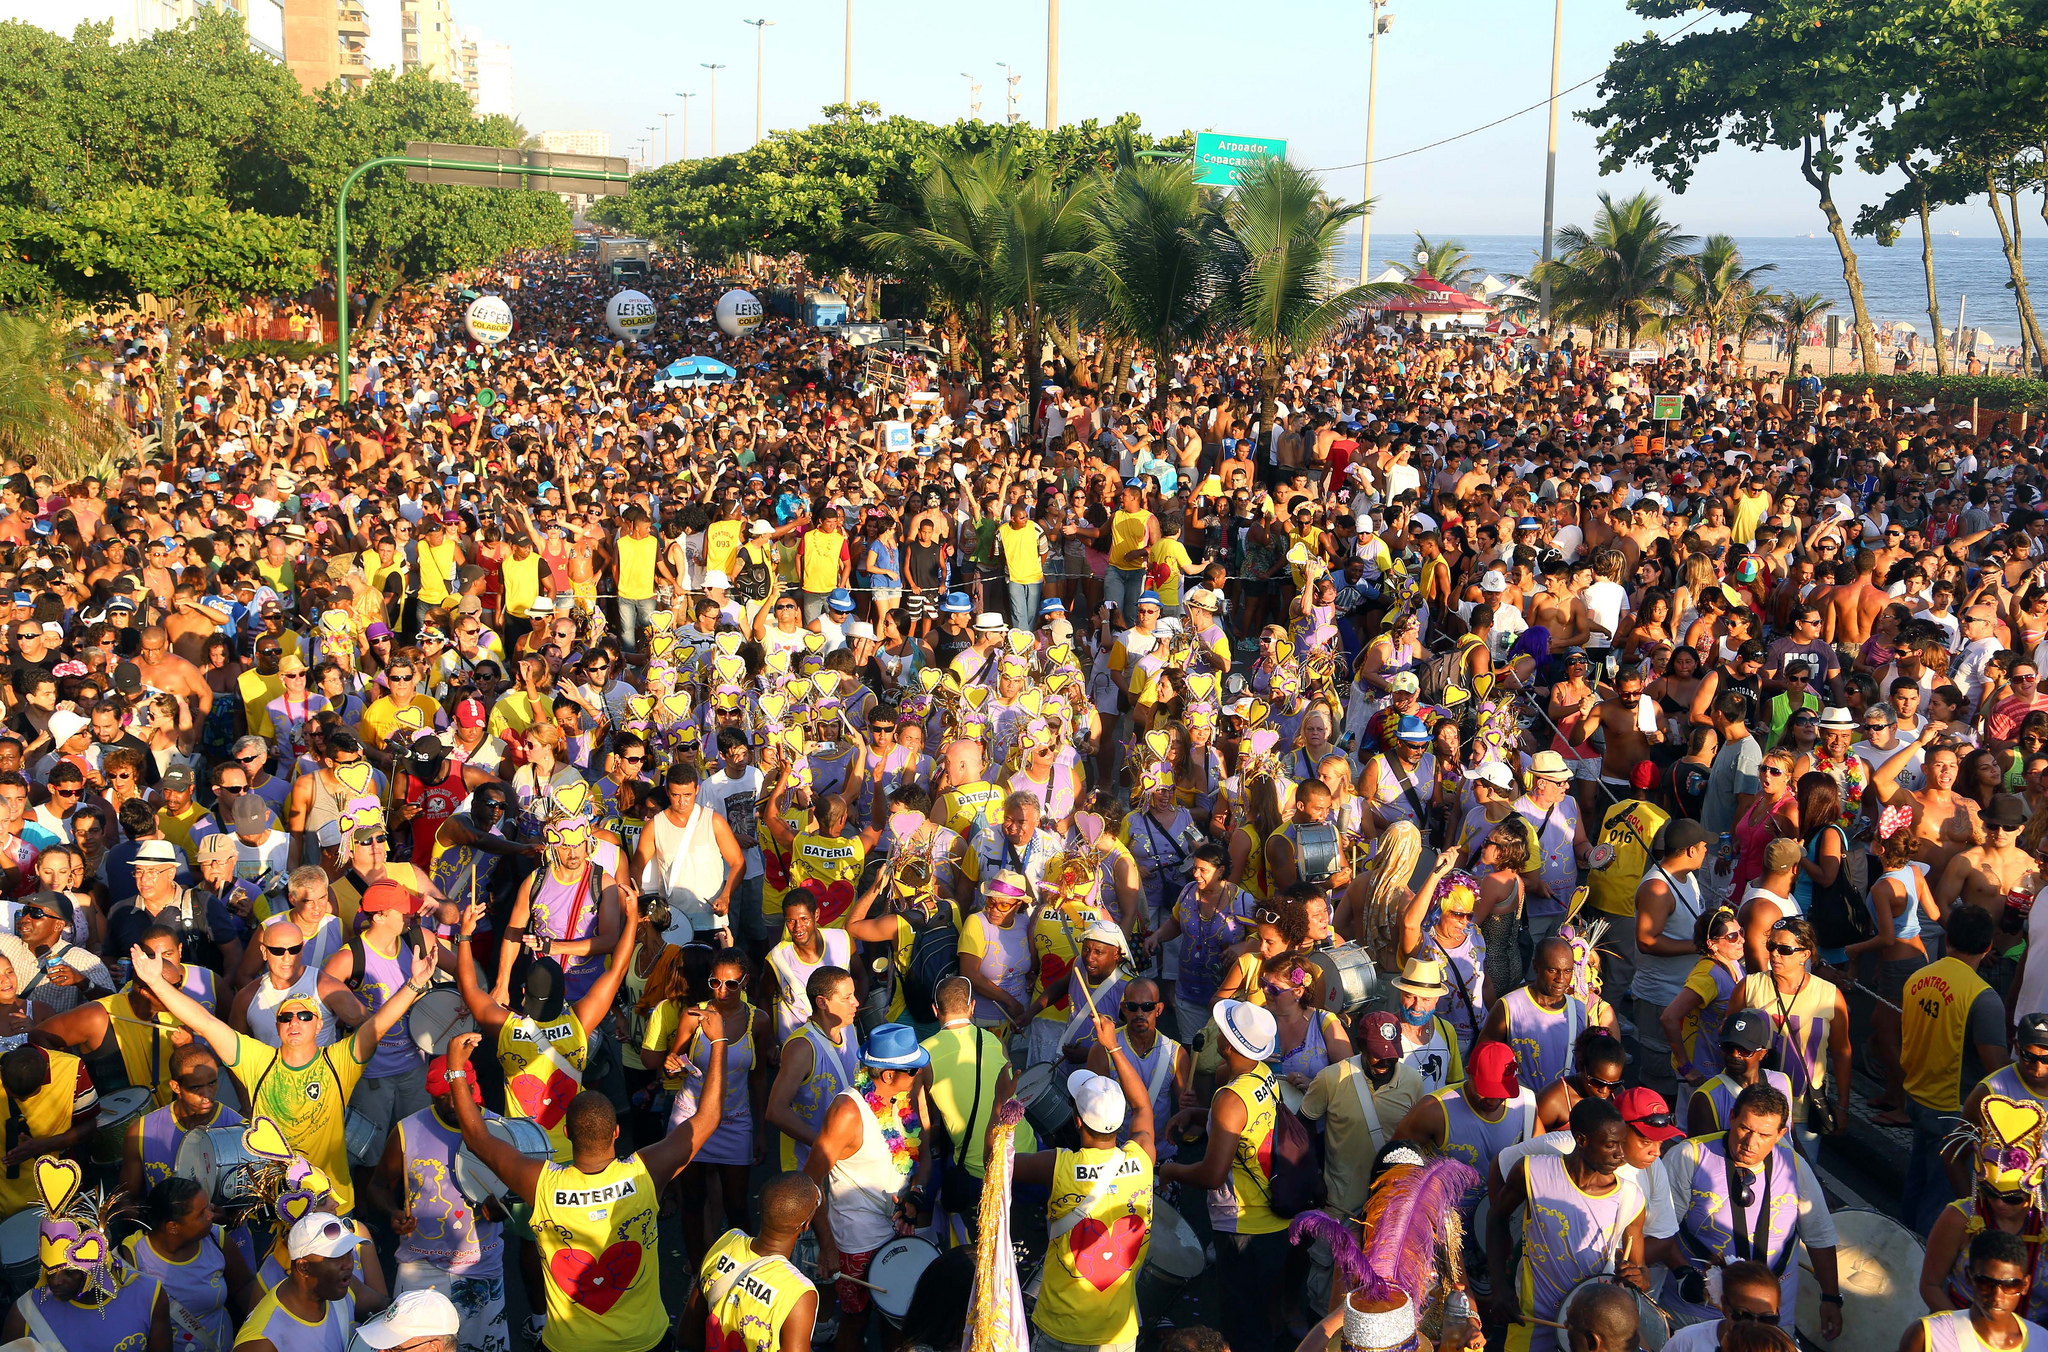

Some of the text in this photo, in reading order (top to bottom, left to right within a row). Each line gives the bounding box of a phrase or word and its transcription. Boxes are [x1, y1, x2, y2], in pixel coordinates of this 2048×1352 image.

[1218, 140, 1268, 153] Arpoador
[1425, 290, 1453, 300] TNT
[472, 305, 488, 320] LEI
[490, 311, 512, 326] SECA
[617, 303, 656, 316] LEI SEC
[735, 303, 762, 316] LEI SE
[472, 321, 508, 332] COLABORE
[959, 791, 1000, 805] BATERIA
[1627, 814, 1644, 834] ROLE
[1610, 829, 1634, 844] 016
[804, 845, 854, 858] BATERIA
[1911, 976, 1954, 1006] CONTROLE
[1919, 998, 1939, 1019] 143
[555, 1181, 635, 1206] BATERIA
[716, 1255, 772, 1305] BAERIA
